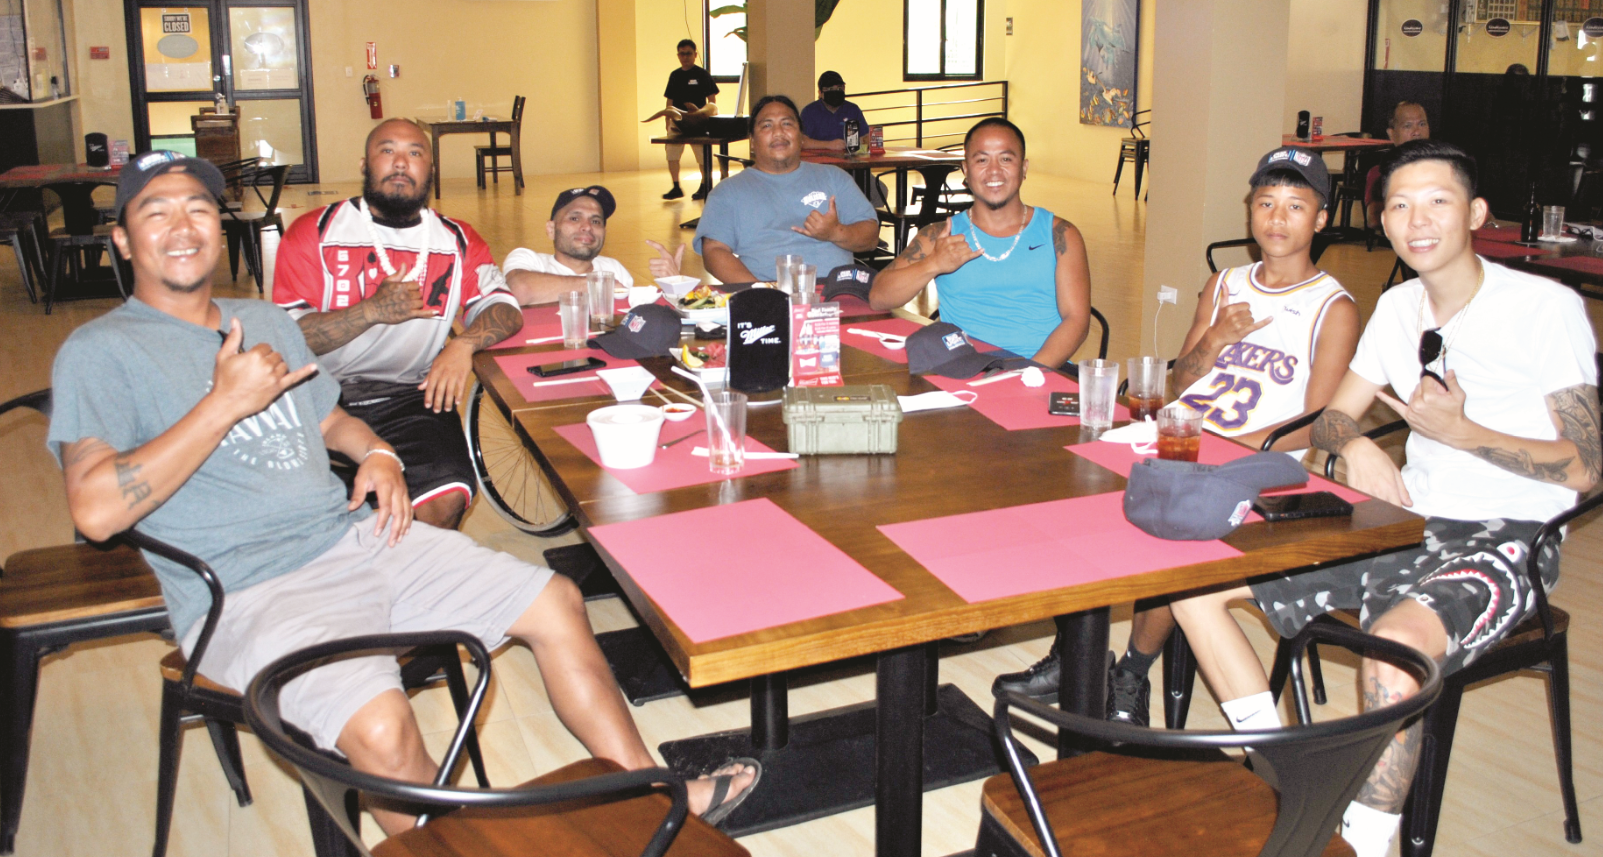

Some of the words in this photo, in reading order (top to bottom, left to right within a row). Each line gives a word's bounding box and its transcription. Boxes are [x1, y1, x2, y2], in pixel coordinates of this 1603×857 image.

[164, 21, 189, 32] CLOSED
[737, 321, 752, 329] IT'S
[740, 324, 776, 345] Miller
[760, 337, 782, 345] TIME.
[1214, 341, 1300, 386] AKERS
[1179, 372, 1263, 432] 23
